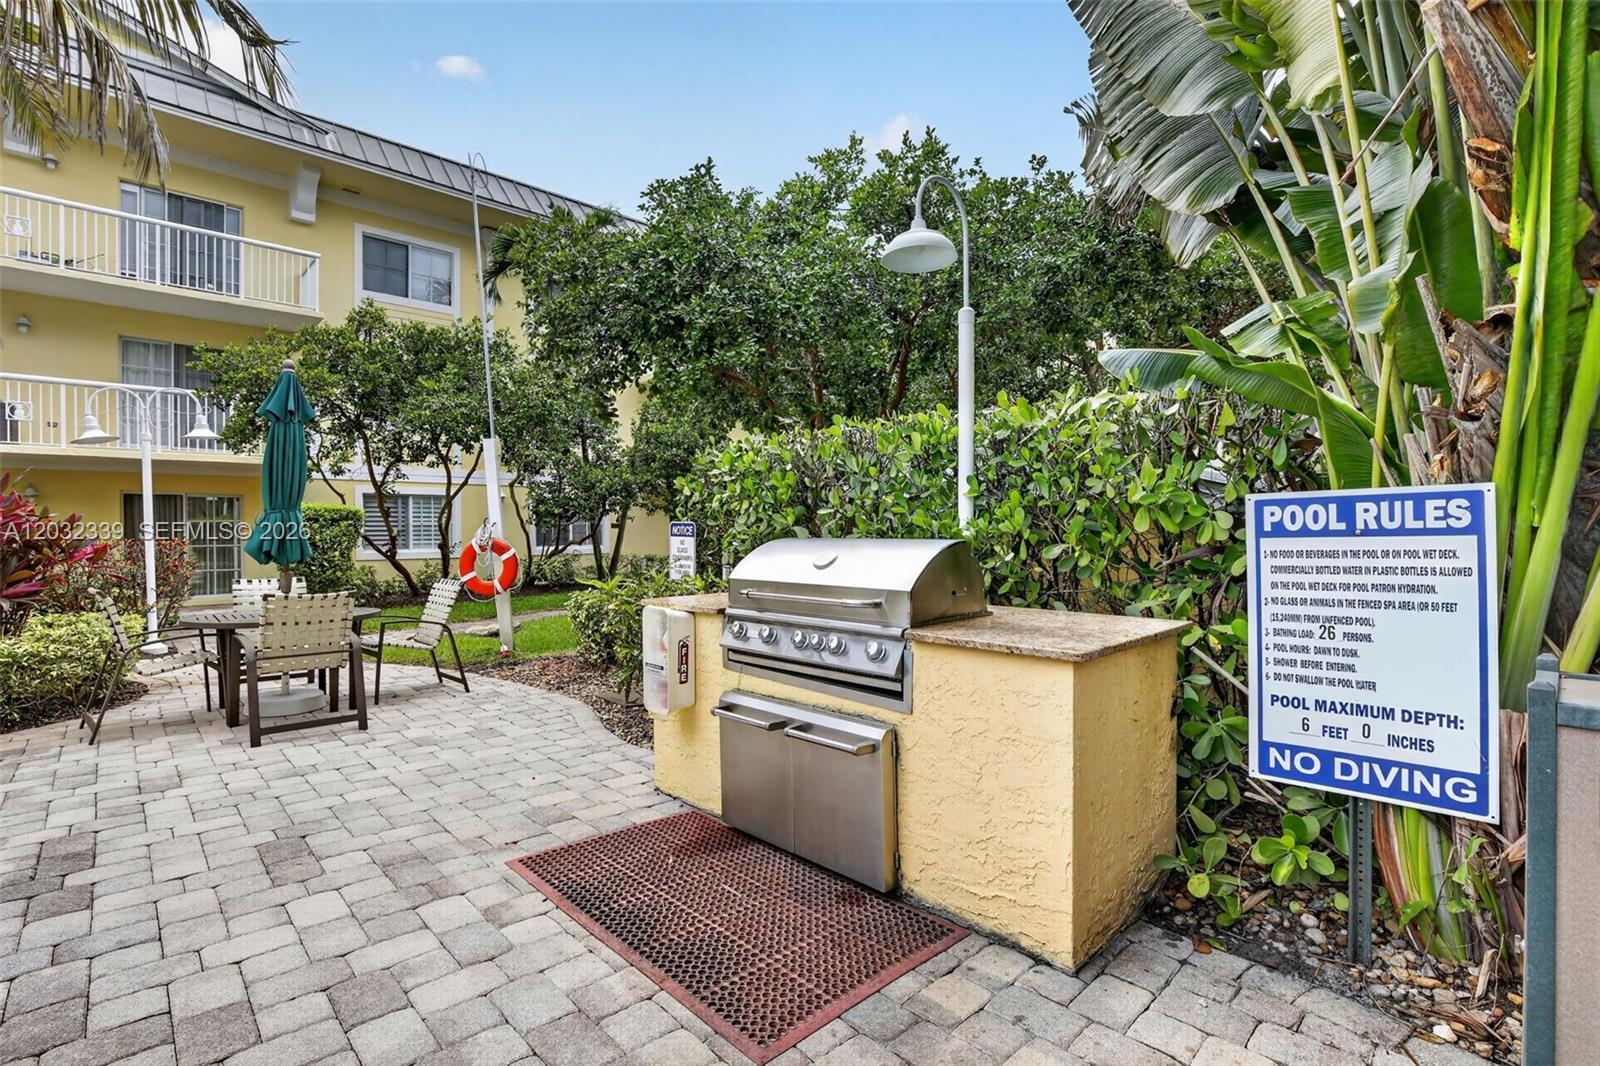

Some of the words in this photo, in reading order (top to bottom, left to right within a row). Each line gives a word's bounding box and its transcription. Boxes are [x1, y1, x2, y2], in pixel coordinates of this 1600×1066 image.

[1263, 503, 1347, 532] POOL
[1356, 498, 1472, 530] RULES
[672, 525, 693, 535] NOTICE
[1270, 550, 1278, 559] NO
[1279, 550, 1294, 559] FOOD
[1296, 550, 1304, 559] OR
[1305, 550, 1340, 559] BEVERAGES
[1342, 550, 1348, 559] IN
[1349, 550, 1361, 559] THE
[1362, 550, 1380, 559] POOL
[1380, 550, 1390, 559] OR
[1392, 550, 1402, 559] ON
[1402, 550, 1421, 559] POOL
[1422, 550, 1437, 559] WET
[1438, 550, 1460, 559] DECK.
[1270, 565, 1315, 574] COMMERCIALLY
[1316, 565, 1342, 575] BOTTLED
[1342, 566, 1363, 576] WATER
[1364, 566, 1372, 576] IN
[1372, 566, 1399, 576] PLASTIC
[1400, 566, 1429, 576] BOTTLES
[1430, 567, 1438, 576] IS
[1438, 567, 1473, 577] ALLOWED
[1270, 581, 1278, 590] ON
[1280, 581, 1290, 590] THE
[1291, 582, 1307, 591] POOL
[1308, 582, 1320, 591] WET
[1322, 582, 1338, 592] DECK
[1338, 582, 1351, 592] FOR
[1352, 583, 1370, 592] POOL
[1370, 583, 1396, 593] PATRON
[1398, 584, 1438, 594] HYDRATION.
[1270, 597, 1279, 606] NO
[1280, 597, 1298, 606] GLASS
[1300, 598, 1308, 607] OR
[1309, 598, 1336, 608] ANIMALS
[1336, 598, 1344, 608] IN
[1344, 599, 1356, 608] THE
[1358, 600, 1382, 609] FENCED
[1383, 600, 1396, 610] SPA
[1398, 600, 1416, 611] AREA
[1417, 601, 1430, 613] (OR
[1431, 602, 1440, 612] 50
[1441, 602, 1458, 612] FEET
[1304, 614, 1321, 624] FROM
[1322, 615, 1354, 626] UNFENCED
[1272, 628, 1298, 638] BATHING
[1298, 629, 1315, 639] LOAD:
[1318, 624, 1336, 640] 26
[1342, 632, 1374, 643] PERSONS.
[1273, 643, 1288, 653] POOL
[1289, 644, 1312, 655] HOURS:
[1314, 646, 1332, 656] DAWN
[1332, 648, 1340, 657] TO
[1342, 648, 1360, 658] DUSK.
[680, 648, 688, 682] FIRE
[1273, 657, 1298, 668] SHOWER
[1300, 659, 1324, 670] BEFORE
[1326, 661, 1358, 673] ENTERING.
[1274, 672, 1282, 681] DO
[1283, 672, 1294, 682] NOT
[1295, 674, 1324, 686] SWALLOW
[1325, 676, 1336, 687] THE
[1338, 678, 1354, 688] POOL
[1270, 694, 1310, 711] POOL
[1314, 698, 1395, 721] MAXIMUM
[1400, 709, 1464, 730] DEPTH:
[1302, 717, 1310, 732] 6
[1322, 725, 1349, 740] FEET
[1362, 724, 1371, 739] 0
[1387, 734, 1435, 753] INCHES
[1269, 746, 1322, 775] NO
[1334, 756, 1478, 804] DIVING
